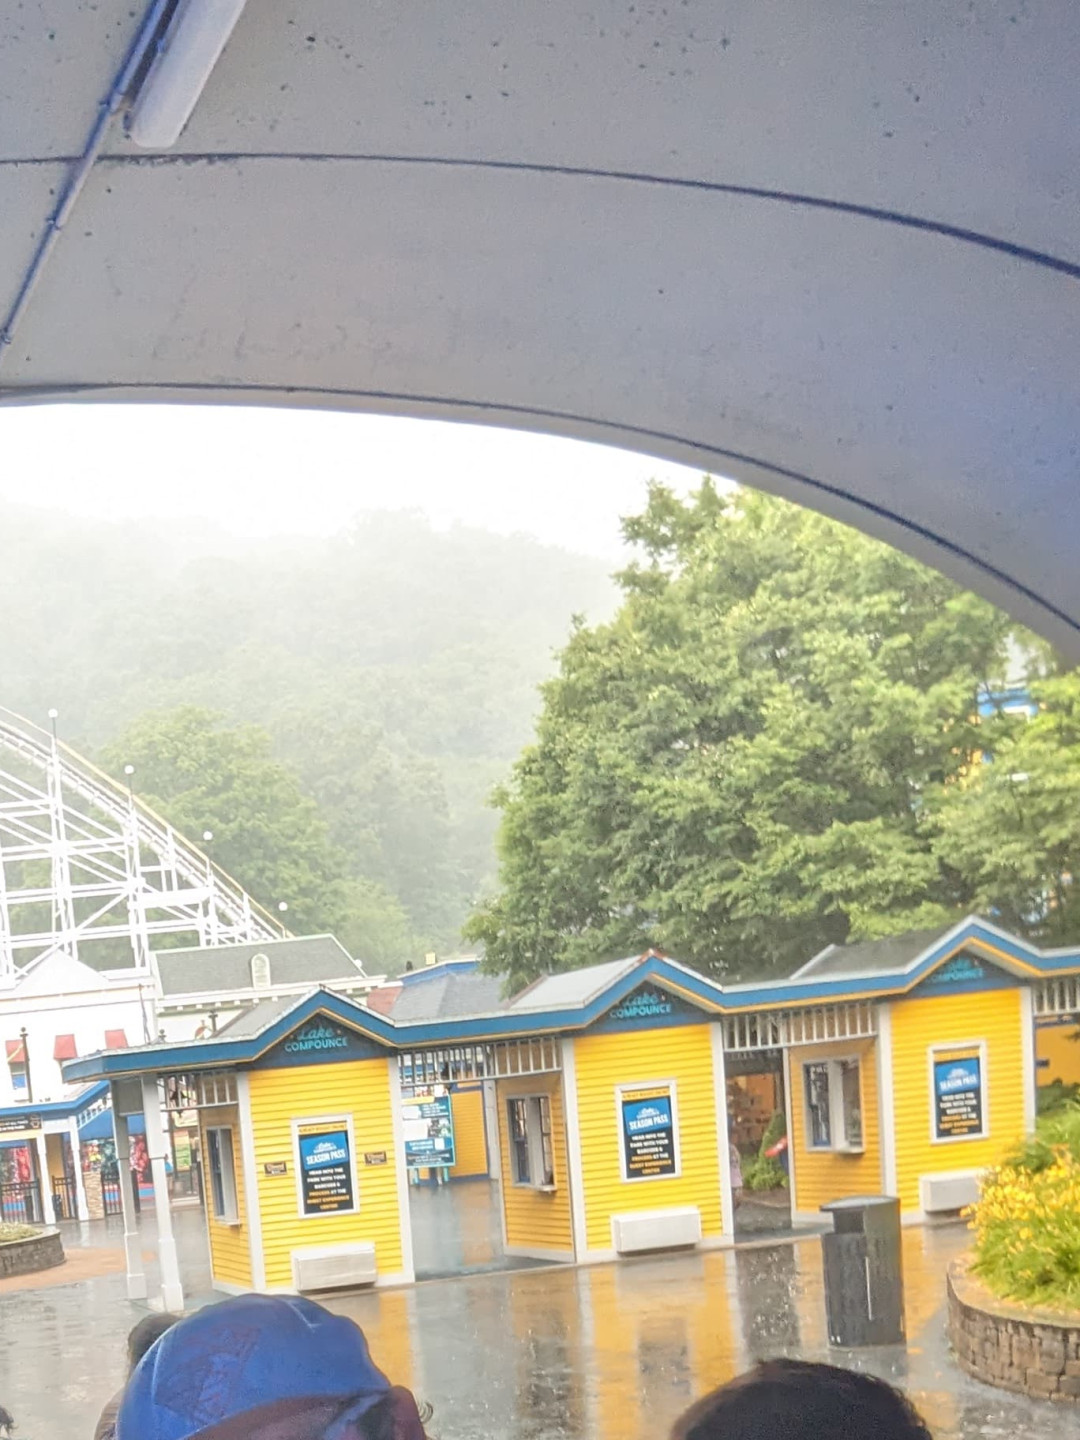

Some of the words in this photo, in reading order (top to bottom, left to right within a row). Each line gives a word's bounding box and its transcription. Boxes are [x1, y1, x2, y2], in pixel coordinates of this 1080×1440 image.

[609, 1004, 672, 1018] COMPOUNCE
[297, 1026, 334, 1039] Lake
[284, 1037, 348, 1053] COMPOUNCE
